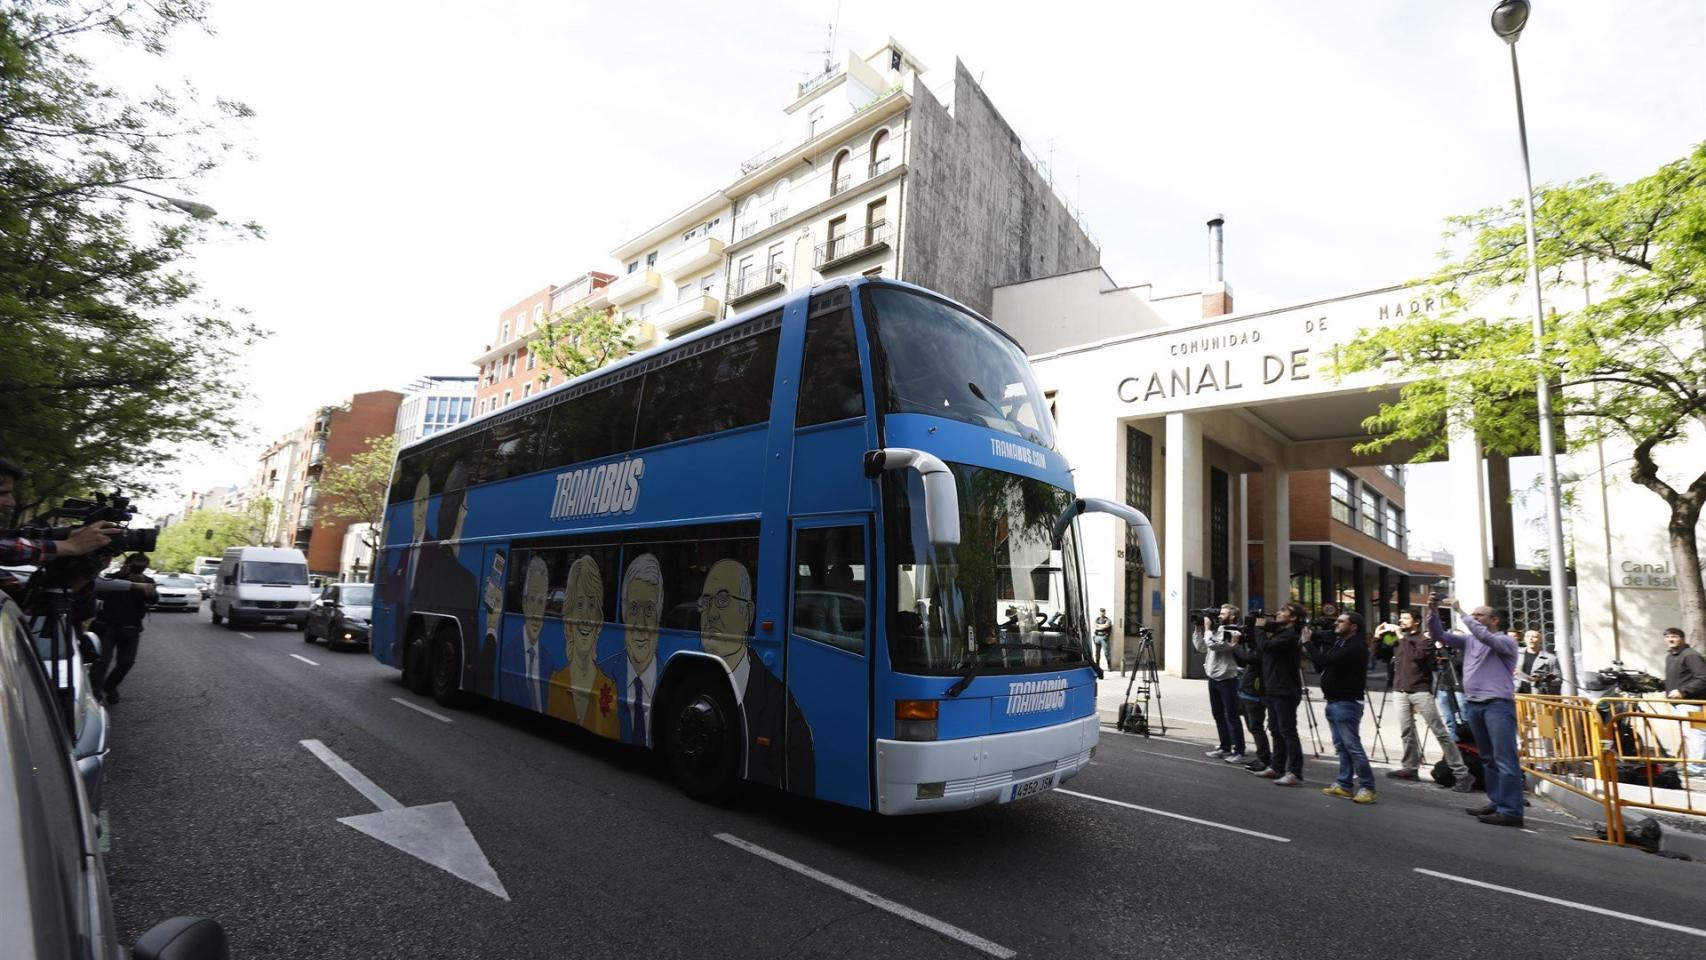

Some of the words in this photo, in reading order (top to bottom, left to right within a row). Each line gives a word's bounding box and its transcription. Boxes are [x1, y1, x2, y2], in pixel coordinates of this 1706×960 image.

[1170, 330, 1262, 356] COMUNIDAD
[1305, 316, 1328, 333] DE
[1379, 298, 1446, 320] MADRI
[1117, 360, 1243, 403] CANAL
[1263, 348, 1310, 385] DE
[990, 438, 1047, 470] TRAMABUS.COM
[1621, 560, 1670, 574] Canal
[1489, 577, 1519, 586] ntrol
[1622, 575, 1643, 587] de
[1017, 780, 1039, 797] 4952
